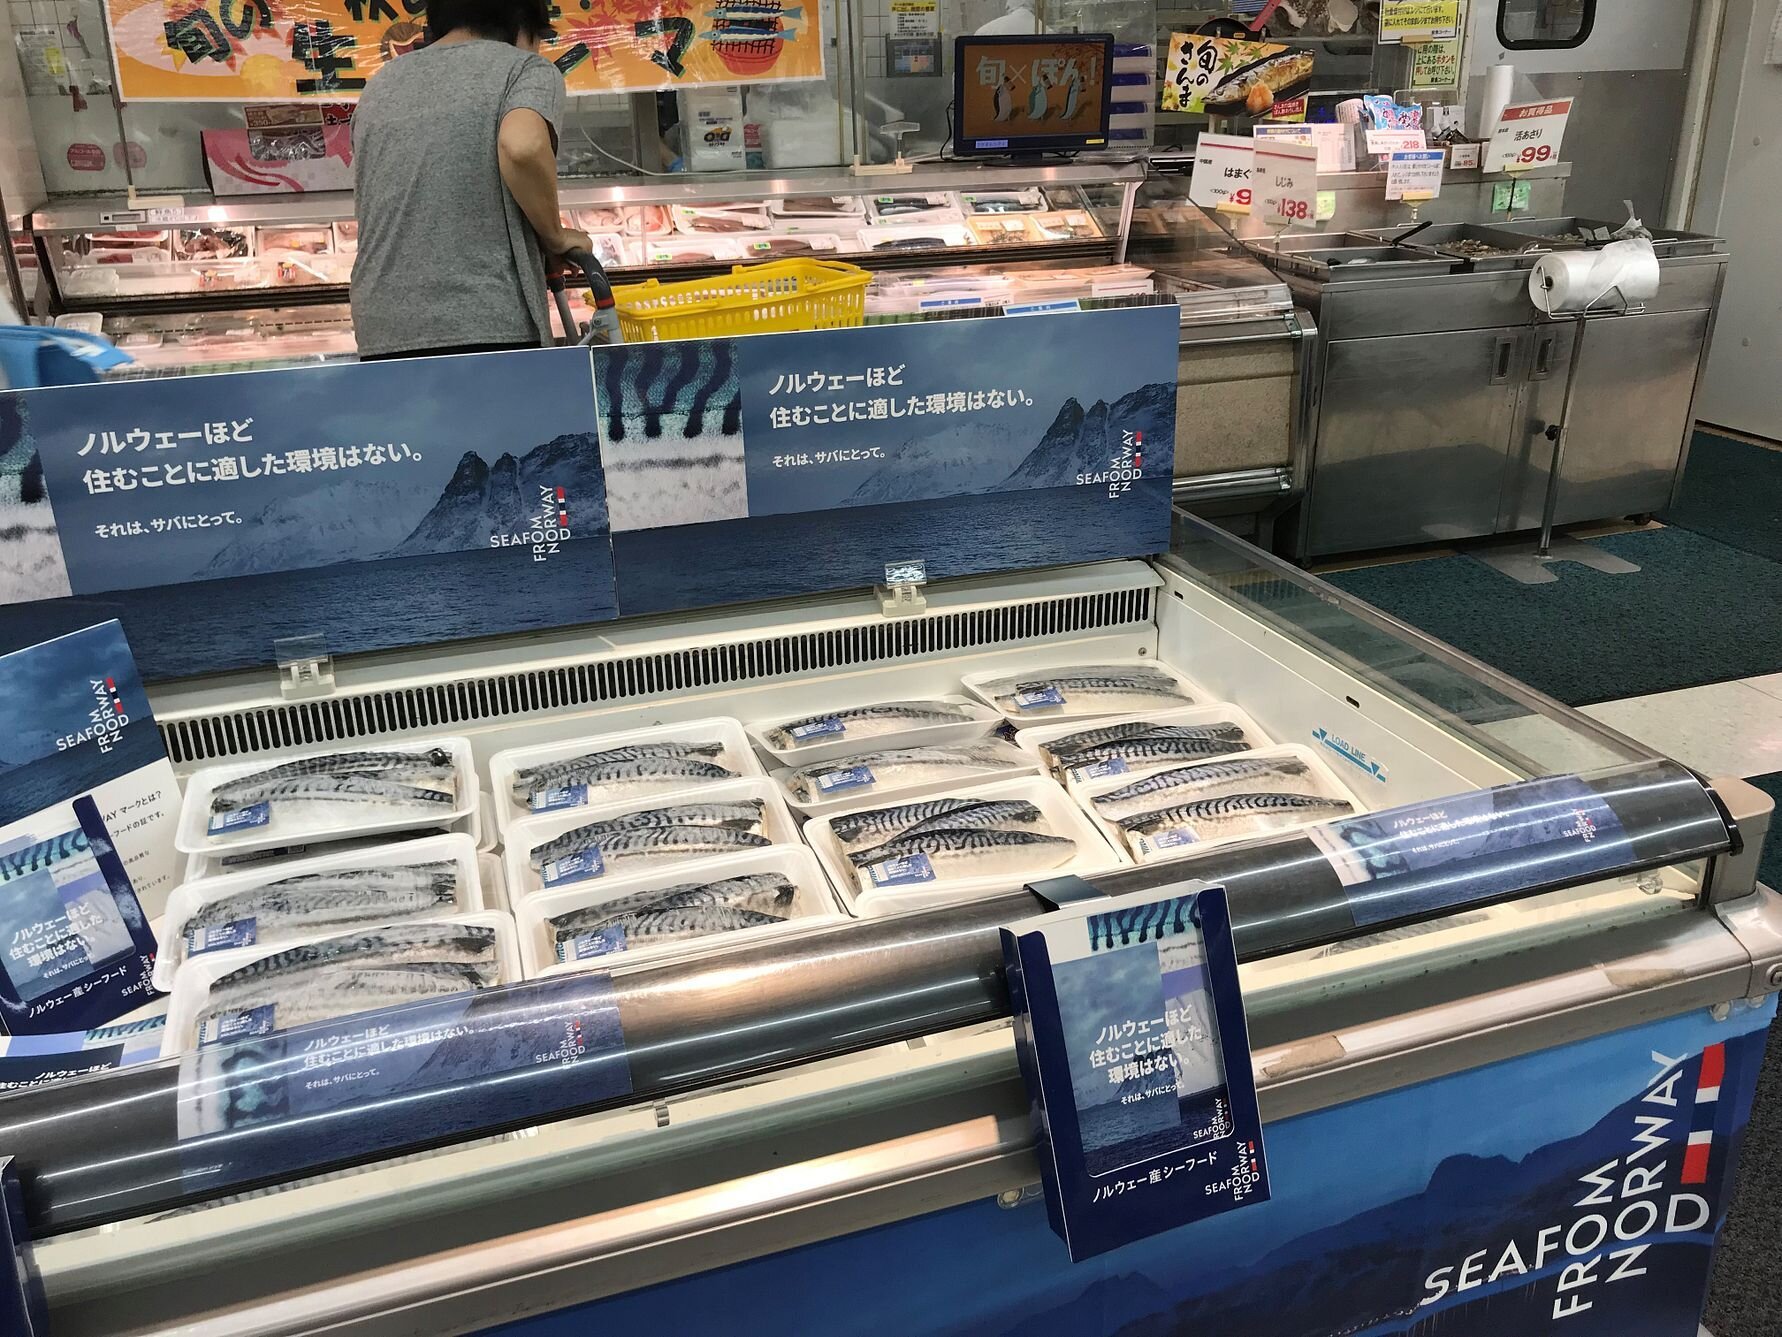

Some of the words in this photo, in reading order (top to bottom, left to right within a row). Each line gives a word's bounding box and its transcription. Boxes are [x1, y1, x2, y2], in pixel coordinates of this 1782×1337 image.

[1175, 40, 1195, 108] さんま
[1196, 39, 1218, 87] 旬の
[1519, 105, 1553, 118] お買得品
[1514, 128, 1544, 142] 活あさり
[1275, 176, 1294, 189] しじみ
[769, 363, 908, 396] ノルウェーほど
[769, 389, 1034, 429] 住むことに適した環境はない。
[77, 417, 255, 457] ノルウェーほど
[83, 441, 423, 495] 住むことに適した環境はない。
[772, 446, 886, 468] それは、サバにとって。
[1121, 429, 1134, 492] NORWAY
[1076, 468, 1143, 486] SEAFOOD
[1108, 456, 1121, 499] FROM
[94, 510, 243, 539] それは、サバにとって。
[490, 528, 571, 548] SEAFOOD
[529, 515, 547, 562] FROM
[539, 485, 561, 554] NORWAY
[89, 679, 124, 743] NORWAY
[56, 714, 129, 751] SEAFOOD
[88, 708, 113, 754] FROM
[1331, 733, 1350, 751] LOAD
[1351, 746, 1366, 762] LINE
[119, 790, 162, 814] マークとは?
[110, 811, 165, 838] フードの証です。
[1562, 824, 1597, 838] SEAFOOD
[9, 914, 104, 961] 住むことに適した
[11, 902, 92, 945] ノルウェーほど
[27, 936, 96, 968] 環境はない。
[28, 965, 128, 1019] ノルウェー産シーフード
[121, 978, 152, 997] SEAFO
[303, 1023, 391, 1052] ノルウェーほど
[564, 1021, 580, 1064] NORWAY
[1095, 1003, 1193, 1046] ノルウェーほど
[535, 1045, 586, 1064] SEAFOOD
[1089, 1025, 1202, 1069] 住むことに適した
[304, 1067, 380, 1090] それは、サバにとって。
[1107, 1052, 1190, 1085] 環境はない。
[1193, 1121, 1231, 1140] SEAFOOD
[1211, 1115, 1220, 1140] ROM
[1092, 1150, 1218, 1204] ノルウェー産シーフード
[1204, 1171, 1260, 1196] SEAFOOD
[1231, 1164, 1244, 1202] FROM
[1236, 1141, 1253, 1194] NORWAY
[1604, 1049, 1689, 1285] NORWAY
[1419, 1192, 1710, 1306] SEAFOOD
[1551, 1158, 1620, 1320] FROM
